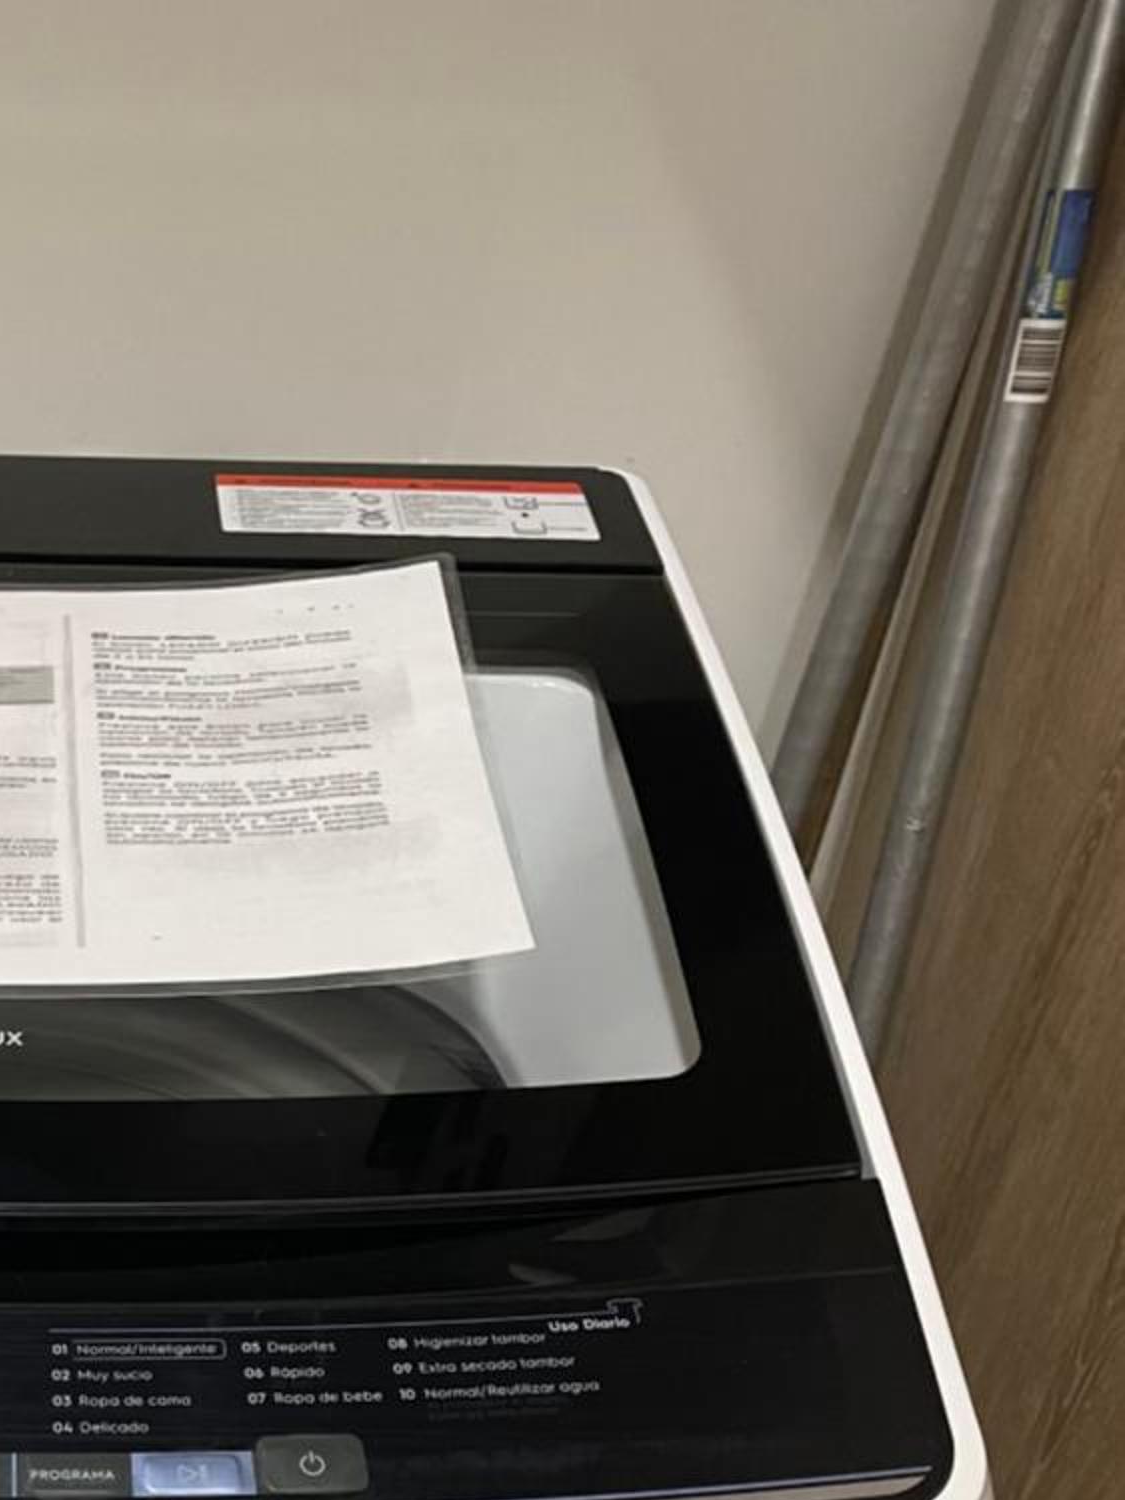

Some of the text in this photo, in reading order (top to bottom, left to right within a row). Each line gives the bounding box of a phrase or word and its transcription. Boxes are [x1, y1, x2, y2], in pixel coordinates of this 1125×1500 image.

[548, 1316, 631, 1332] Uso Diario
[241, 1341, 337, 1355] 05 Deportes
[387, 1332, 546, 1351] 08 Higienizar tambor
[51, 1343, 68, 1356] 01
[392, 1355, 575, 1375] 09 Extra secado tambor
[51, 1368, 154, 1384] 02 Muy sucio
[243, 1367, 264, 1380] 06
[398, 1388, 416, 1401] 10
[559, 1380, 601, 1396] agua
[51, 1394, 192, 1409] 03 Ropa de cama
[247, 1392, 267, 1405] 07
[273, 1392, 316, 1405] Ropa
[319, 1392, 339, 1402] de
[51, 1420, 150, 1435] 04 Delicado
[29, 1468, 116, 1482] PROGRAMA
